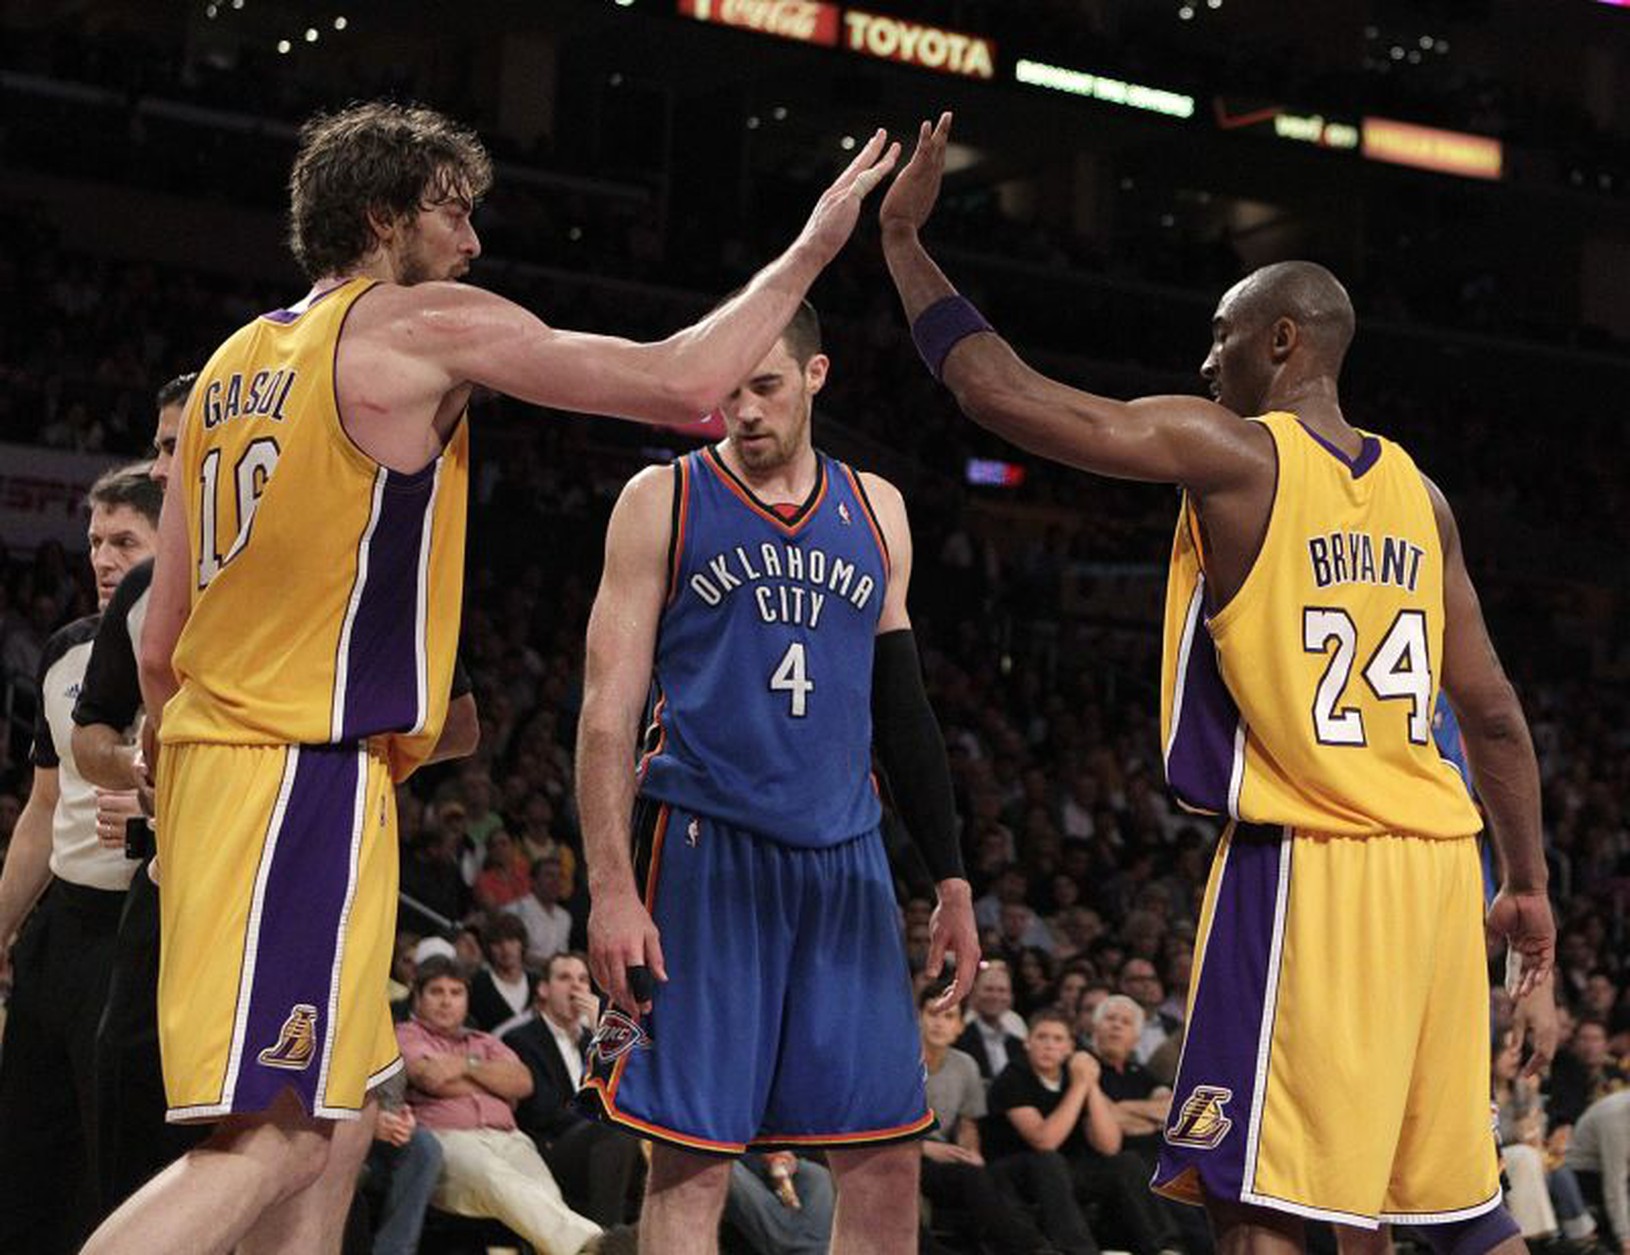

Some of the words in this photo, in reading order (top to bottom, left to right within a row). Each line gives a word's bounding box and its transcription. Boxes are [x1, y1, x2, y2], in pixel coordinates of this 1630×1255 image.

[844, 10, 994, 79] TOYOTA
[204, 370, 296, 430] GASOL
[690, 543, 875, 609] OKLAHOMA
[1308, 532, 1425, 592] BRYANT
[755, 586, 825, 629] CITY
[770, 642, 814, 717] 4
[1302, 605, 1432, 748] 24
